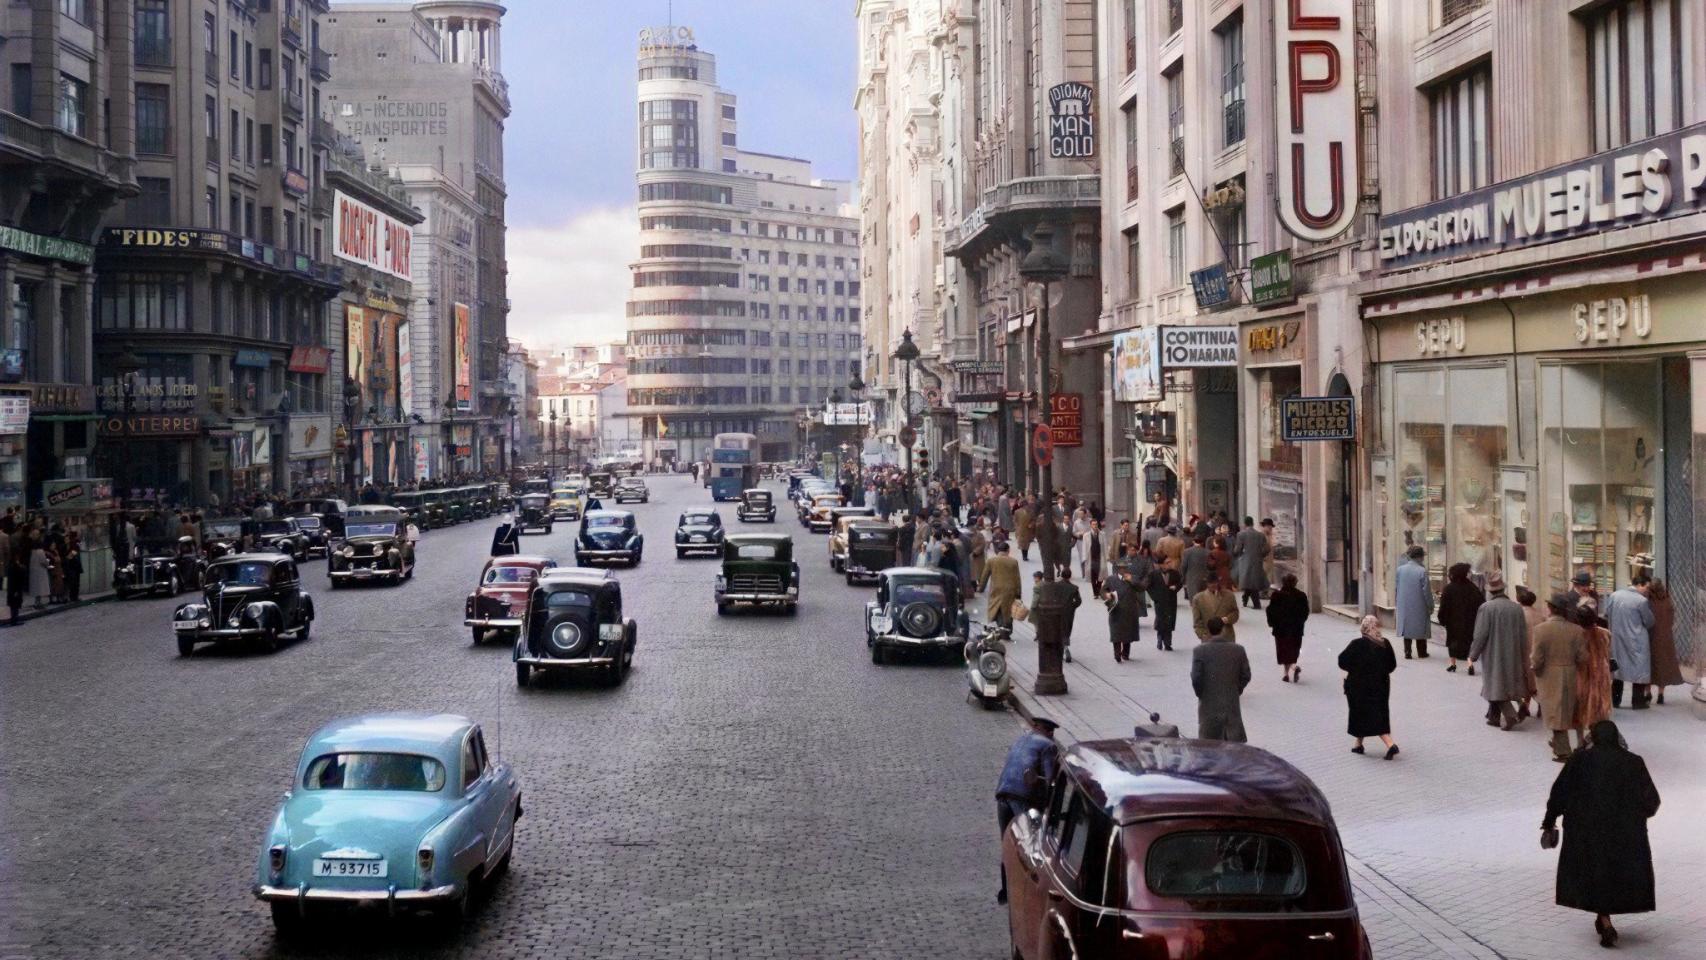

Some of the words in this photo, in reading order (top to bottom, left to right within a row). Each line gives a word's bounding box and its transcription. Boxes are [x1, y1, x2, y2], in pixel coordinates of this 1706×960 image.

[1049, 84, 1093, 106] IDIOMAS
[345, 121, 448, 136] TRANSPORTES
[1051, 116, 1093, 136] MAN
[1051, 137, 1094, 156] GOLD
[1380, 203, 1489, 260] EXPOSICION
[1493, 148, 1672, 244] MUEBLES
[111, 229, 198, 248] "FIDES"
[1572, 294, 1652, 343] SEPU
[1165, 331, 1238, 346] CONTINUA
[1416, 315, 1466, 354] SEPU
[1165, 347, 1188, 363] 10
[1189, 348, 1237, 363] MAÑANA
[1287, 401, 1350, 417] MUEBLES
[1291, 416, 1348, 430] PICAZO
[1291, 429, 1349, 437] ENTRESUELO
[321, 862, 380, 876] M-93715
